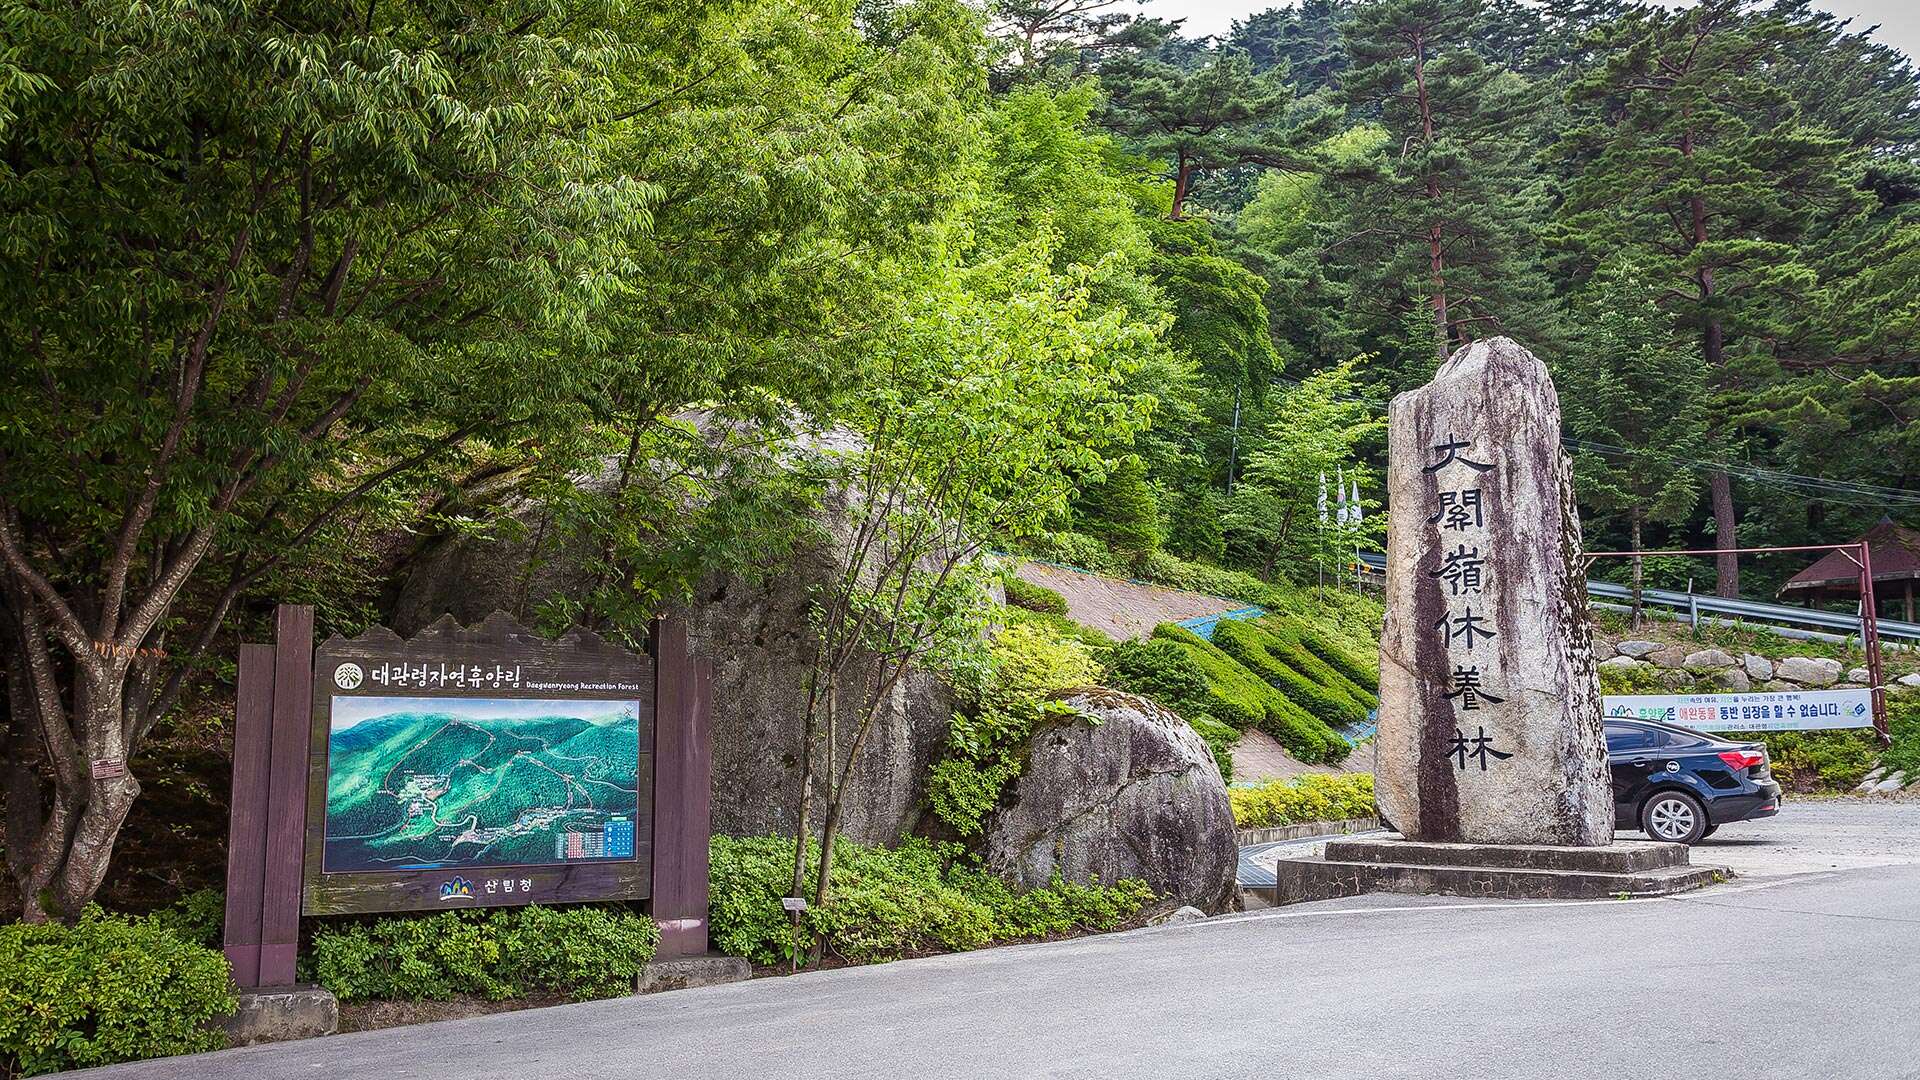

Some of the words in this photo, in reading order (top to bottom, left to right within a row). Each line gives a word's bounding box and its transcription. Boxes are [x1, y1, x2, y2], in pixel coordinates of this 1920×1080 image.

[371, 662, 520, 688] 대관령자연휴양림
[580, 682, 617, 690] Recreation
[617, 682, 639, 690] Forest
[1679, 706, 1716, 721] 애완동물
[1719, 706, 1739, 720] 동반
[1742, 705, 1771, 720] 입장을
[1773, 704, 1784, 719] 할
[1786, 704, 1797, 718] 수
[1799, 702, 1841, 718] 없습니다.
[484, 879, 532, 894] 산림청
